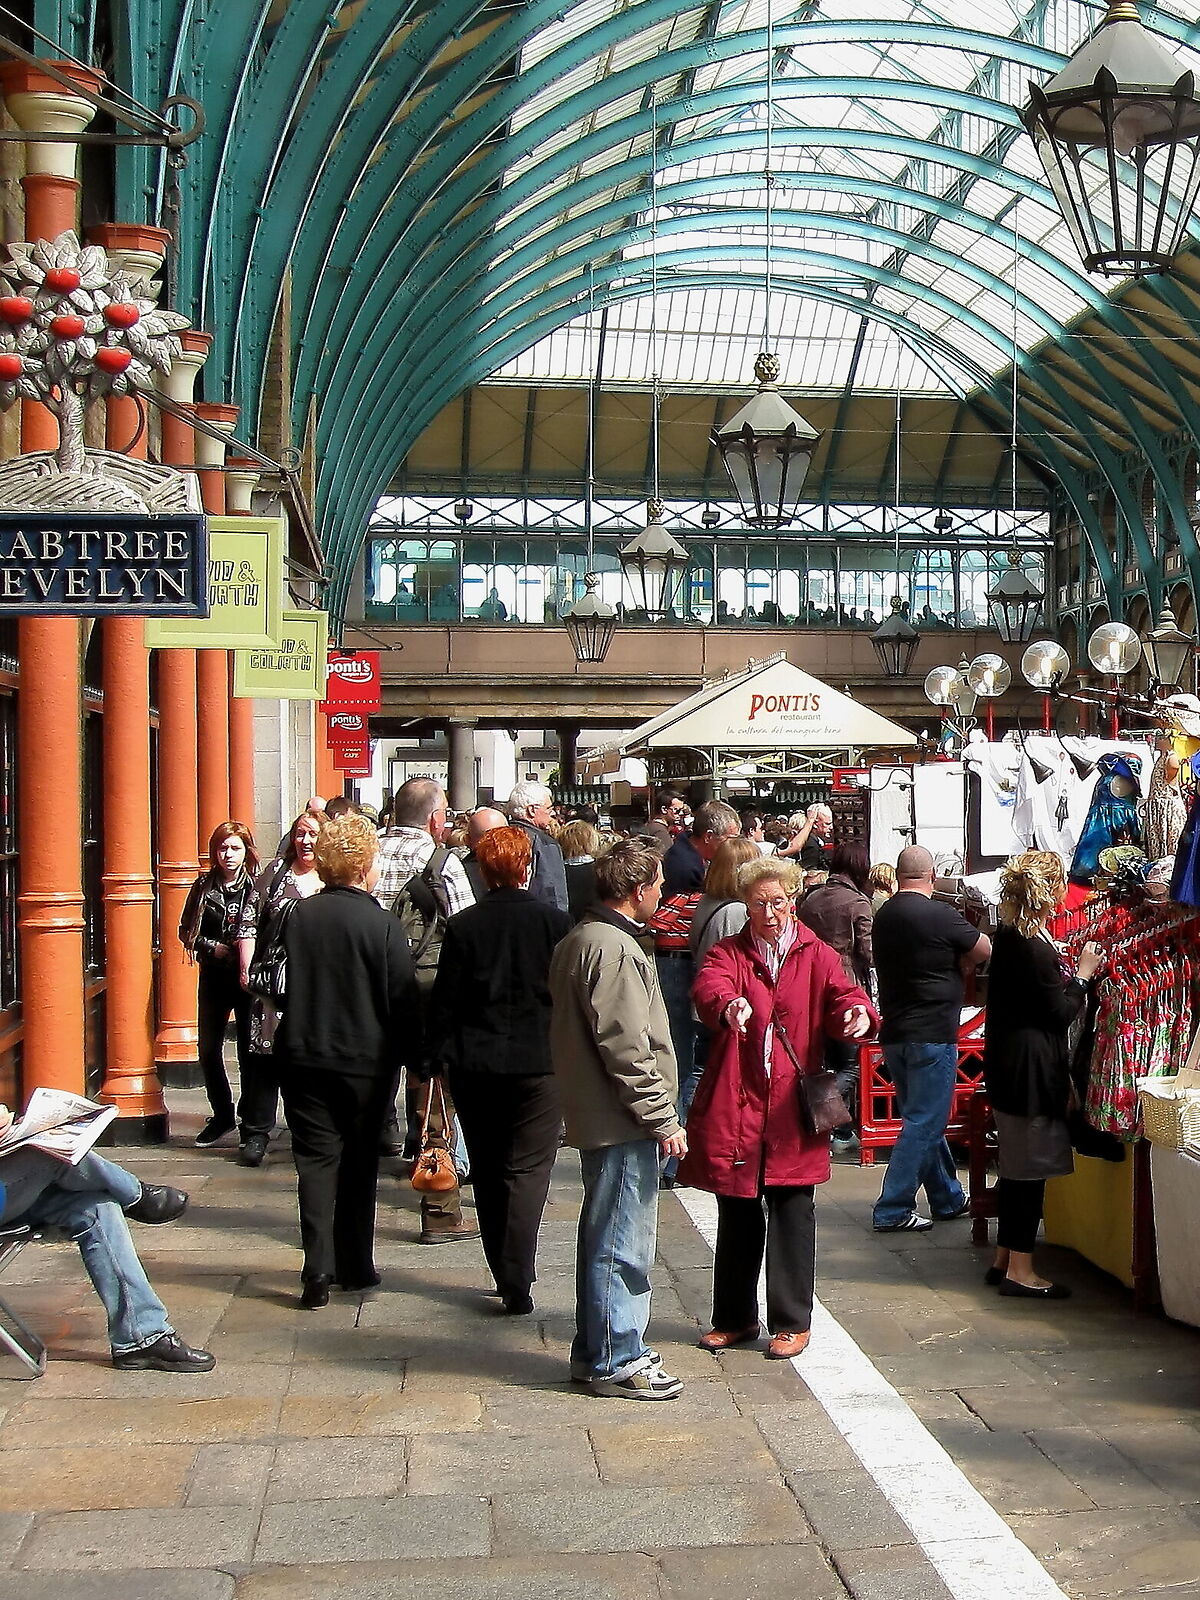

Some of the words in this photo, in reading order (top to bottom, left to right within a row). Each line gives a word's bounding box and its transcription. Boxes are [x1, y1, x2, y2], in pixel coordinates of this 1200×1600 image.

[0, 530, 189, 560] ABTREE
[1, 567, 188, 597] EVELYN
[237, 560, 256, 583] &
[250, 655, 312, 671] GOLIATH
[326, 660, 371, 680] ponti's
[748, 692, 821, 720] PONTI'S
[331, 714, 362, 728] ponti's
